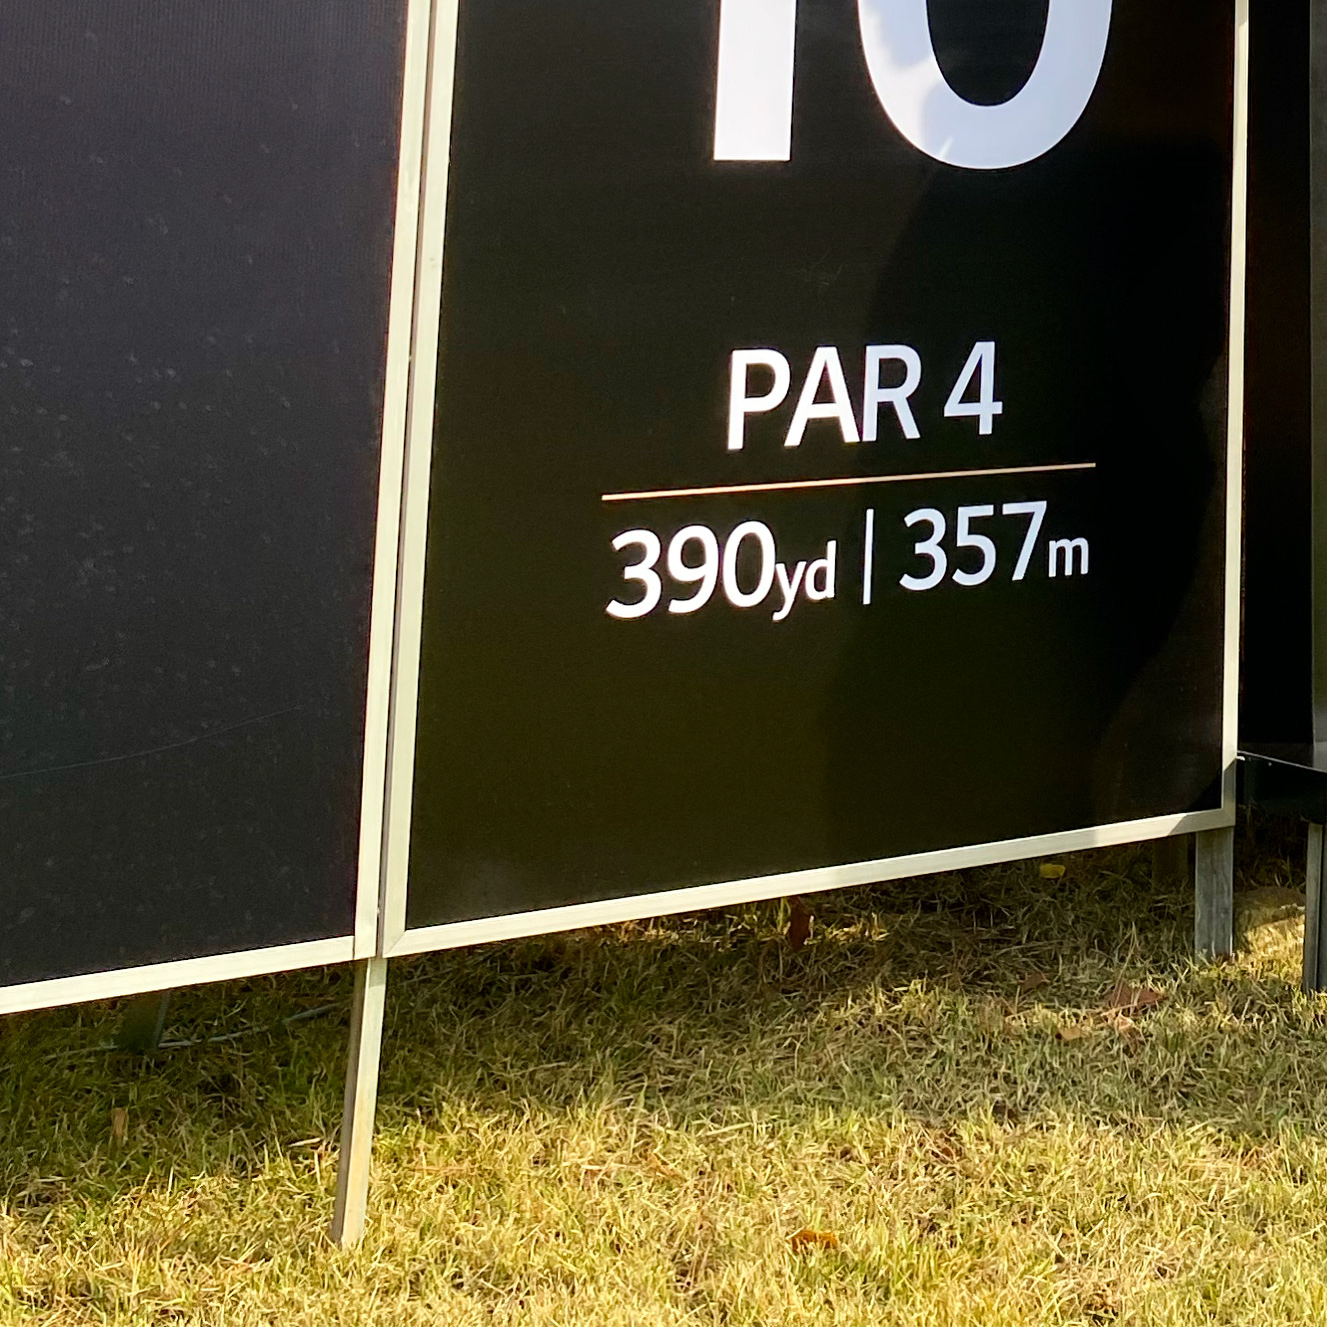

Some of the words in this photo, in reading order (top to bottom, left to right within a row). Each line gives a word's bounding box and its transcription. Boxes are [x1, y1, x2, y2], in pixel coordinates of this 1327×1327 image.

[727, 344, 922, 451] PAR
[943, 341, 1003, 435] 4
[605, 520, 837, 622] 390yd
[899, 500, 1090, 591] 357m
